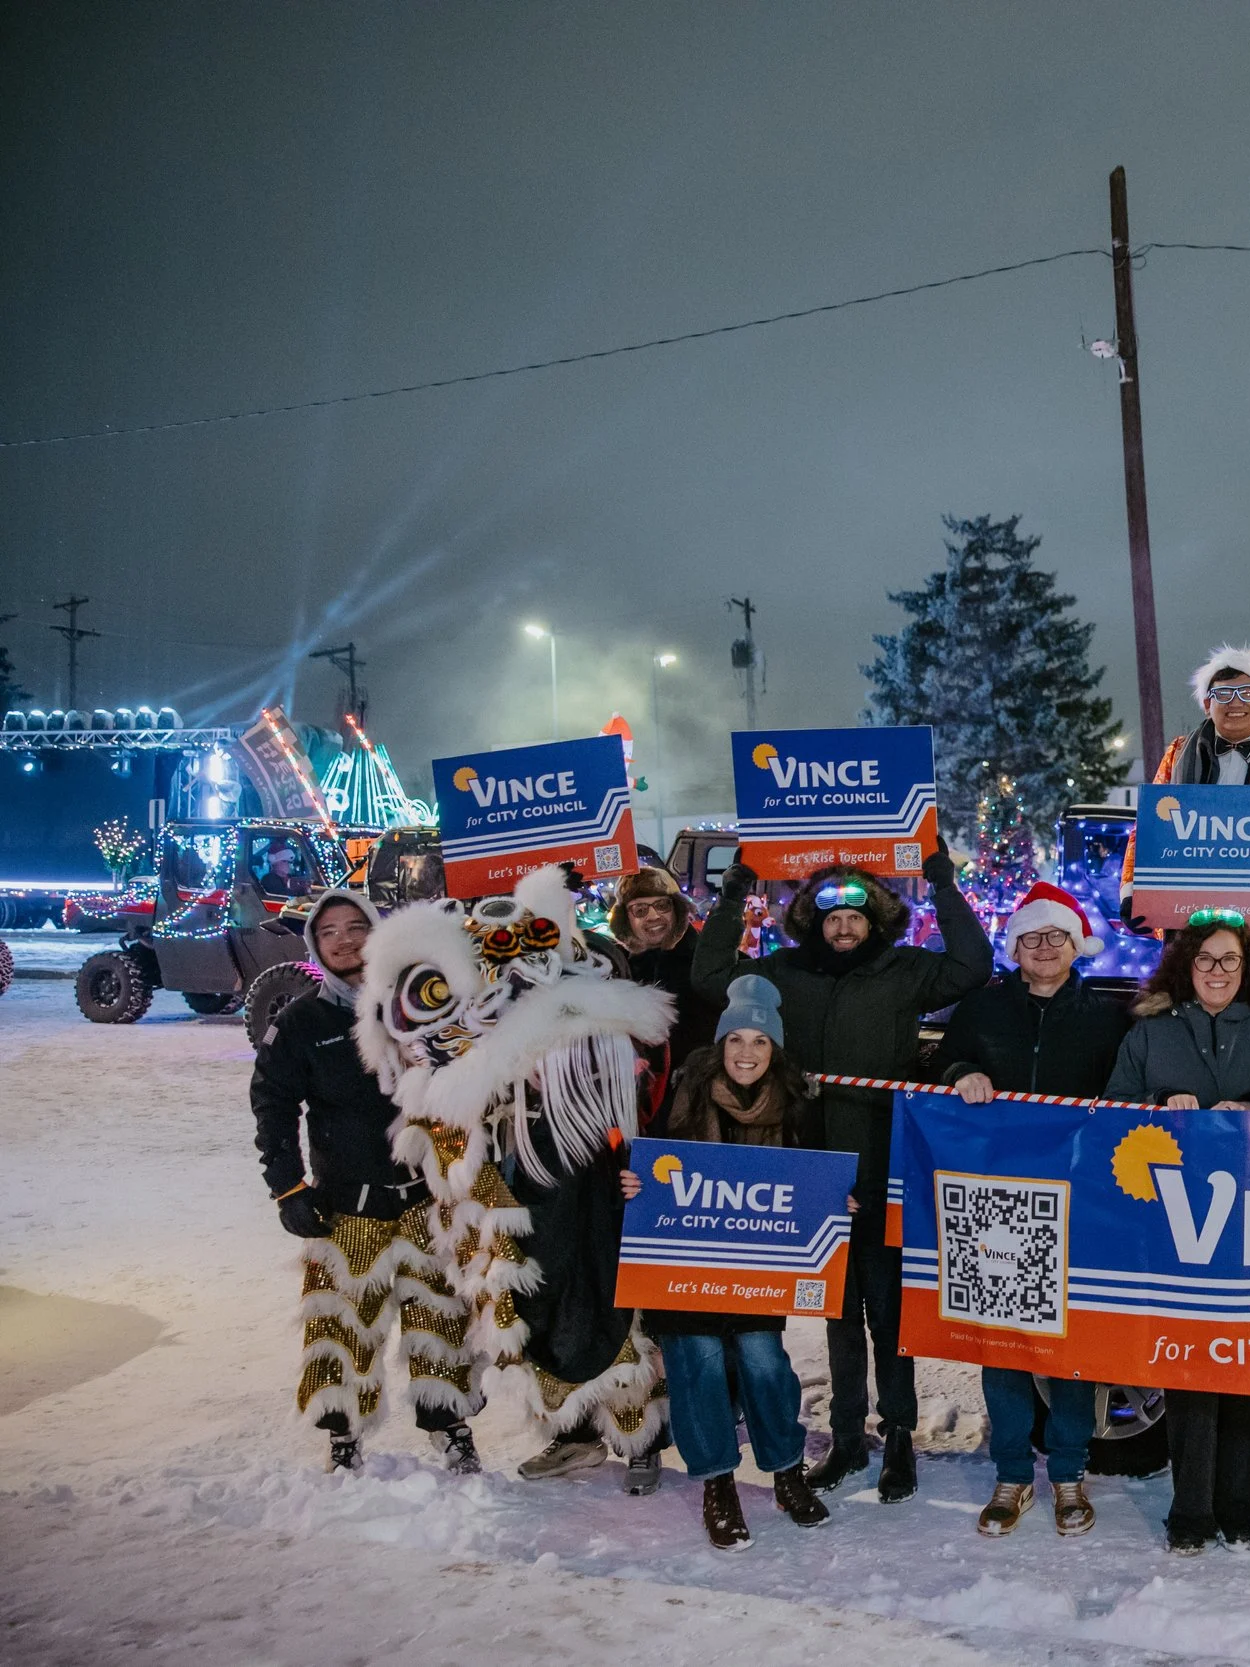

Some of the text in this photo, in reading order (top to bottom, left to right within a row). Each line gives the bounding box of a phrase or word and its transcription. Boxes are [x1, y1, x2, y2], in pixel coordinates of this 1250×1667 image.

[767, 756, 881, 788] VINCE
[467, 770, 577, 808] VINCE
[763, 792, 890, 808] for CITY COUNCIL
[466, 800, 587, 829] for CITY COUNCIL
[783, 851, 887, 865] Let's Rise Together
[1161, 847, 1178, 859] for
[1183, 846, 1215, 858] CITY
[516, 864, 538, 876] Rise
[670, 1170, 794, 1214] VINCE
[655, 1214, 800, 1234] for CITY COUNCIL
[984, 1248, 1016, 1261] VINCE
[668, 1280, 787, 1300] Let's Rise Together
[950, 1331, 965, 1341] Paid
[982, 1338, 1008, 1348] Friends
[1148, 1336, 1195, 1365] for
